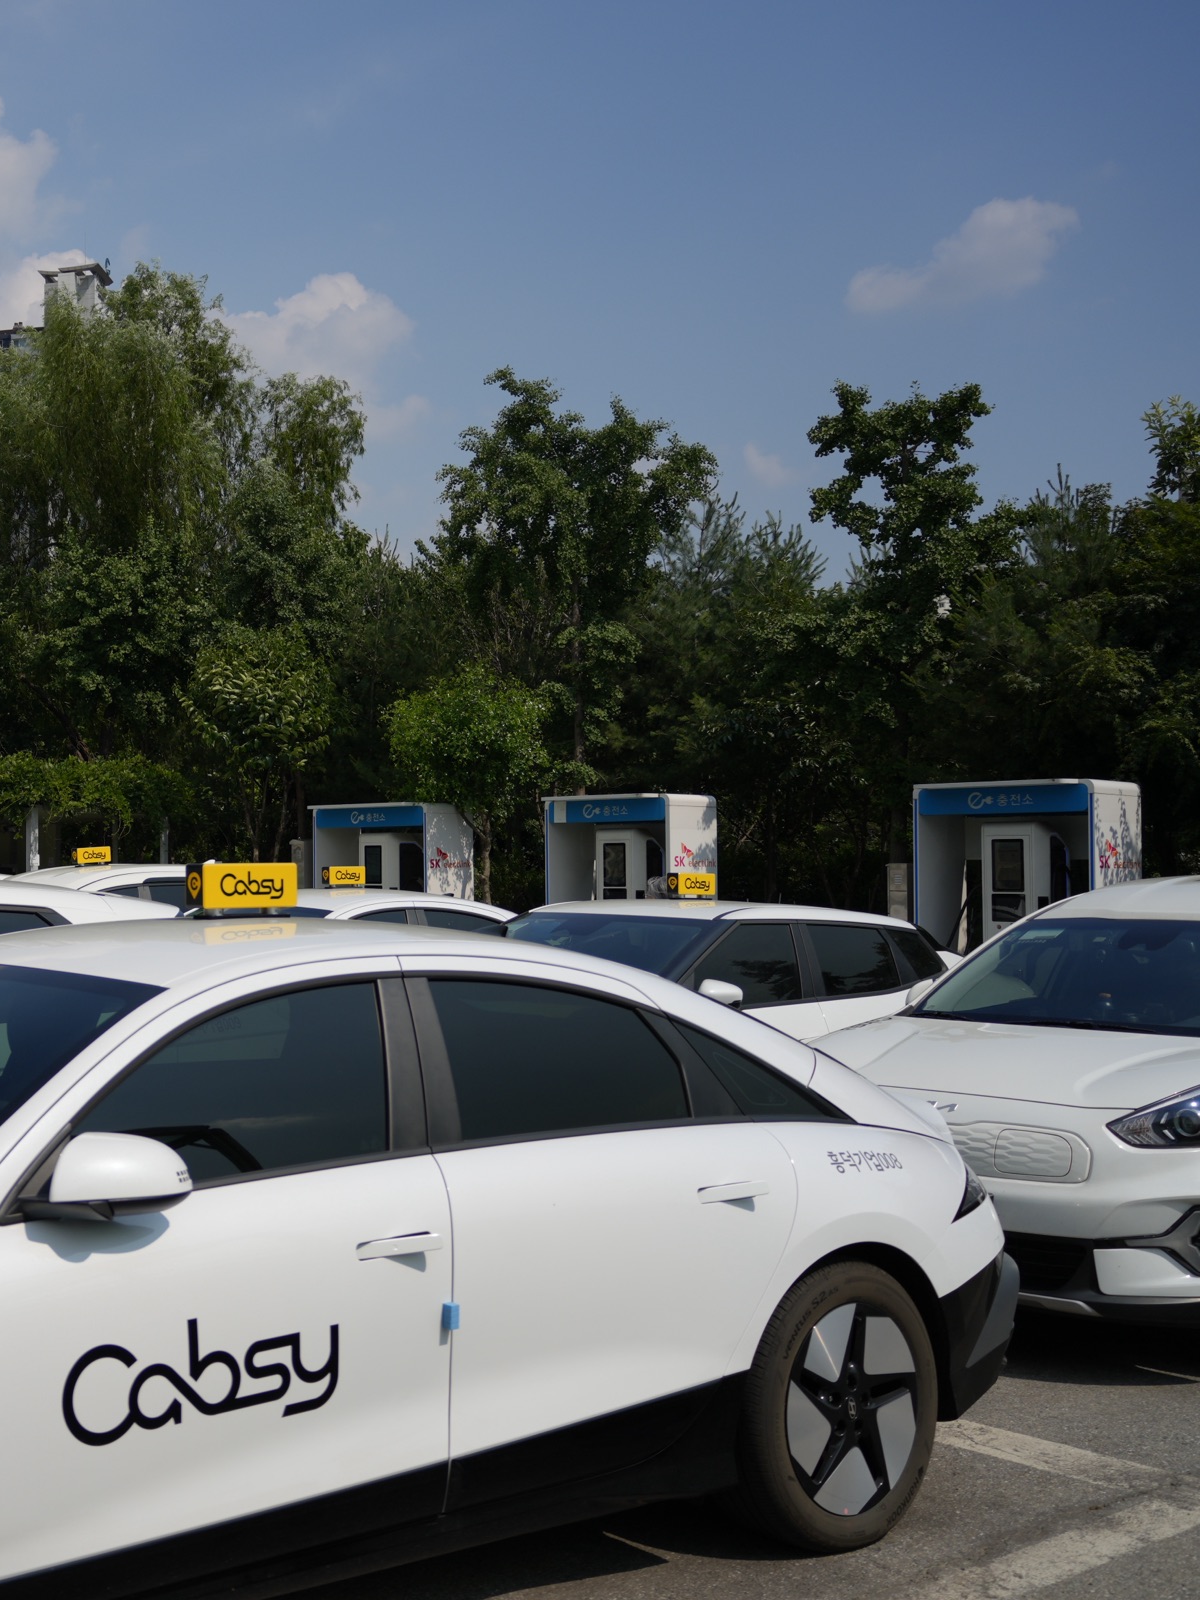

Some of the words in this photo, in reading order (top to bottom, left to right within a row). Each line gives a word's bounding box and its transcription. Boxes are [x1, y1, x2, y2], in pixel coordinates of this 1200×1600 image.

[997, 794, 1034, 806] 충전소
[366, 812, 386, 822] 충전소
[603, 806, 628, 816] 충전소
[82, 850, 106, 860] Cabsy
[674, 855, 686, 867] SK
[430, 858, 441, 868] SK
[1099, 855, 1110, 869] SK
[335, 870, 360, 881] Cabsy
[220, 870, 284, 900] Cabsy
[684, 877, 710, 891] Cabsy
[826, 1150, 903, 1174] 흥덕기업008
[62, 1318, 339, 1446] Cabsy
